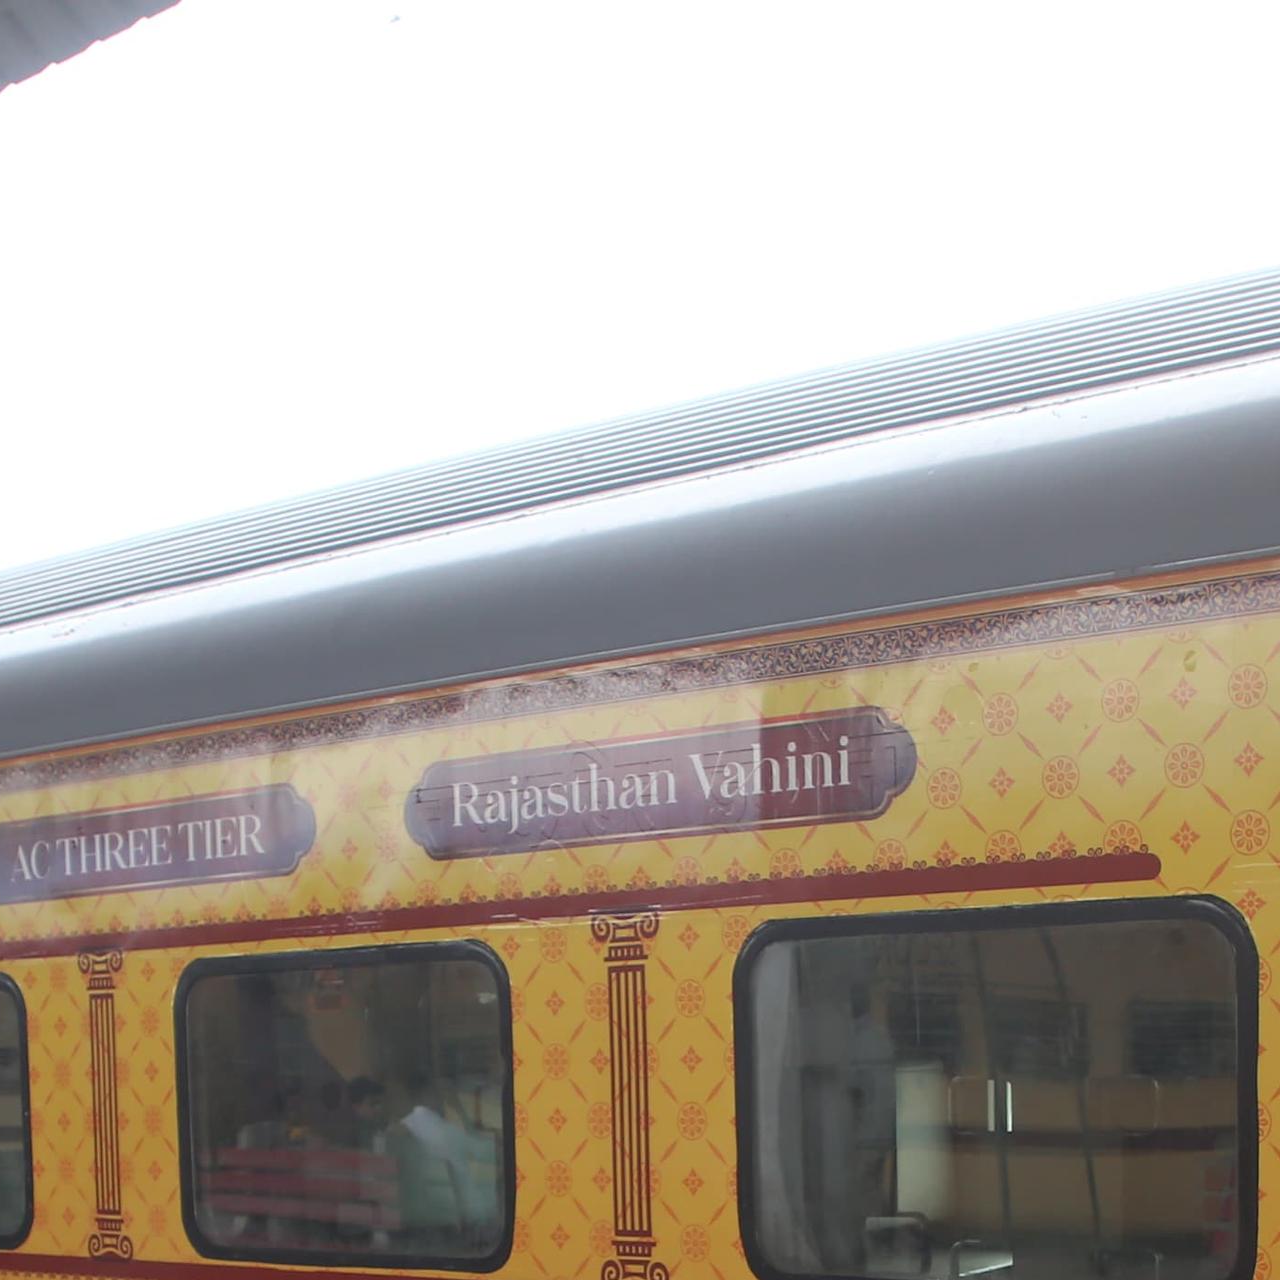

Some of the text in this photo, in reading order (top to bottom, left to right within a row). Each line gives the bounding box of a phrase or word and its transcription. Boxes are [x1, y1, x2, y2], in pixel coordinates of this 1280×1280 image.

[452, 736, 851, 835] Rajasthan Vahini
[10, 814, 265, 883] AC THREE TIER
